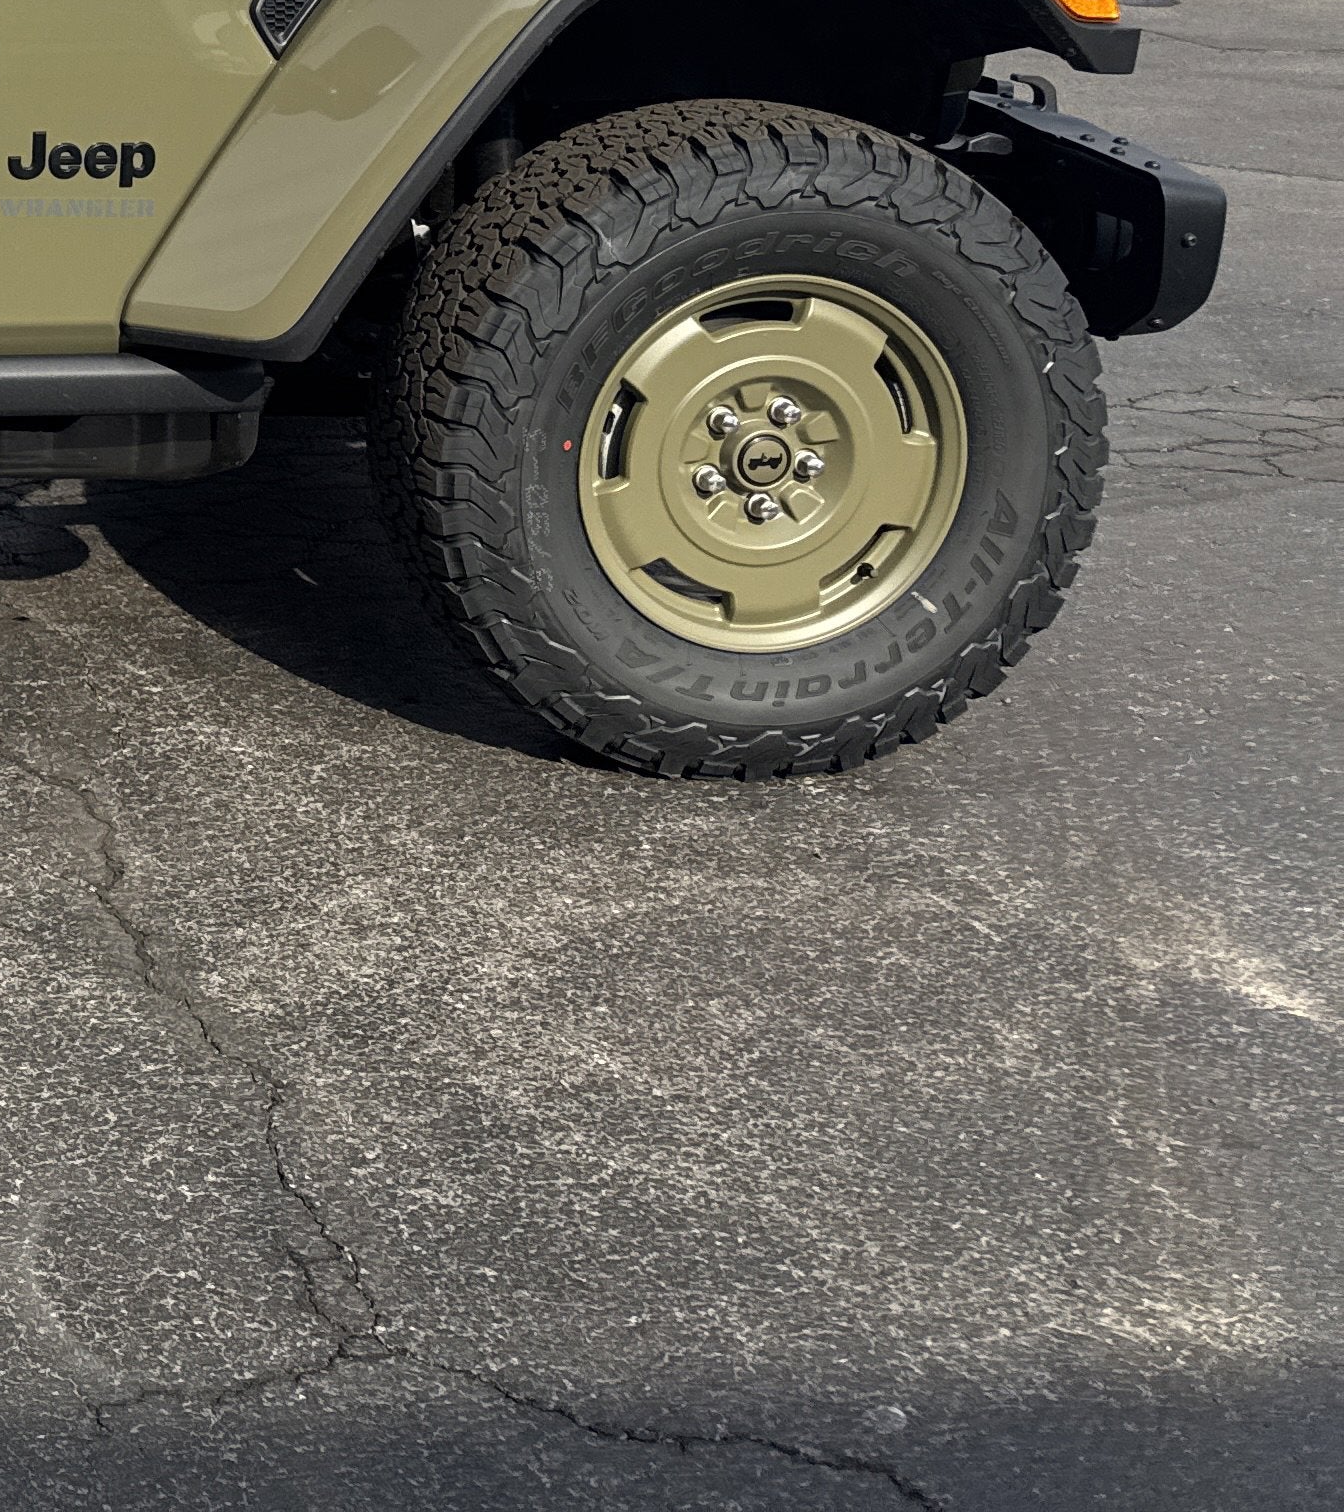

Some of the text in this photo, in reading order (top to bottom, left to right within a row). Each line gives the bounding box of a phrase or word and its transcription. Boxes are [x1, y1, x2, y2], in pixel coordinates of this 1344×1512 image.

[7, 130, 156, 188] Jeep
[555, 228, 922, 415] BFGoodrich
[729, 487, 1019, 708] All-Terrain
